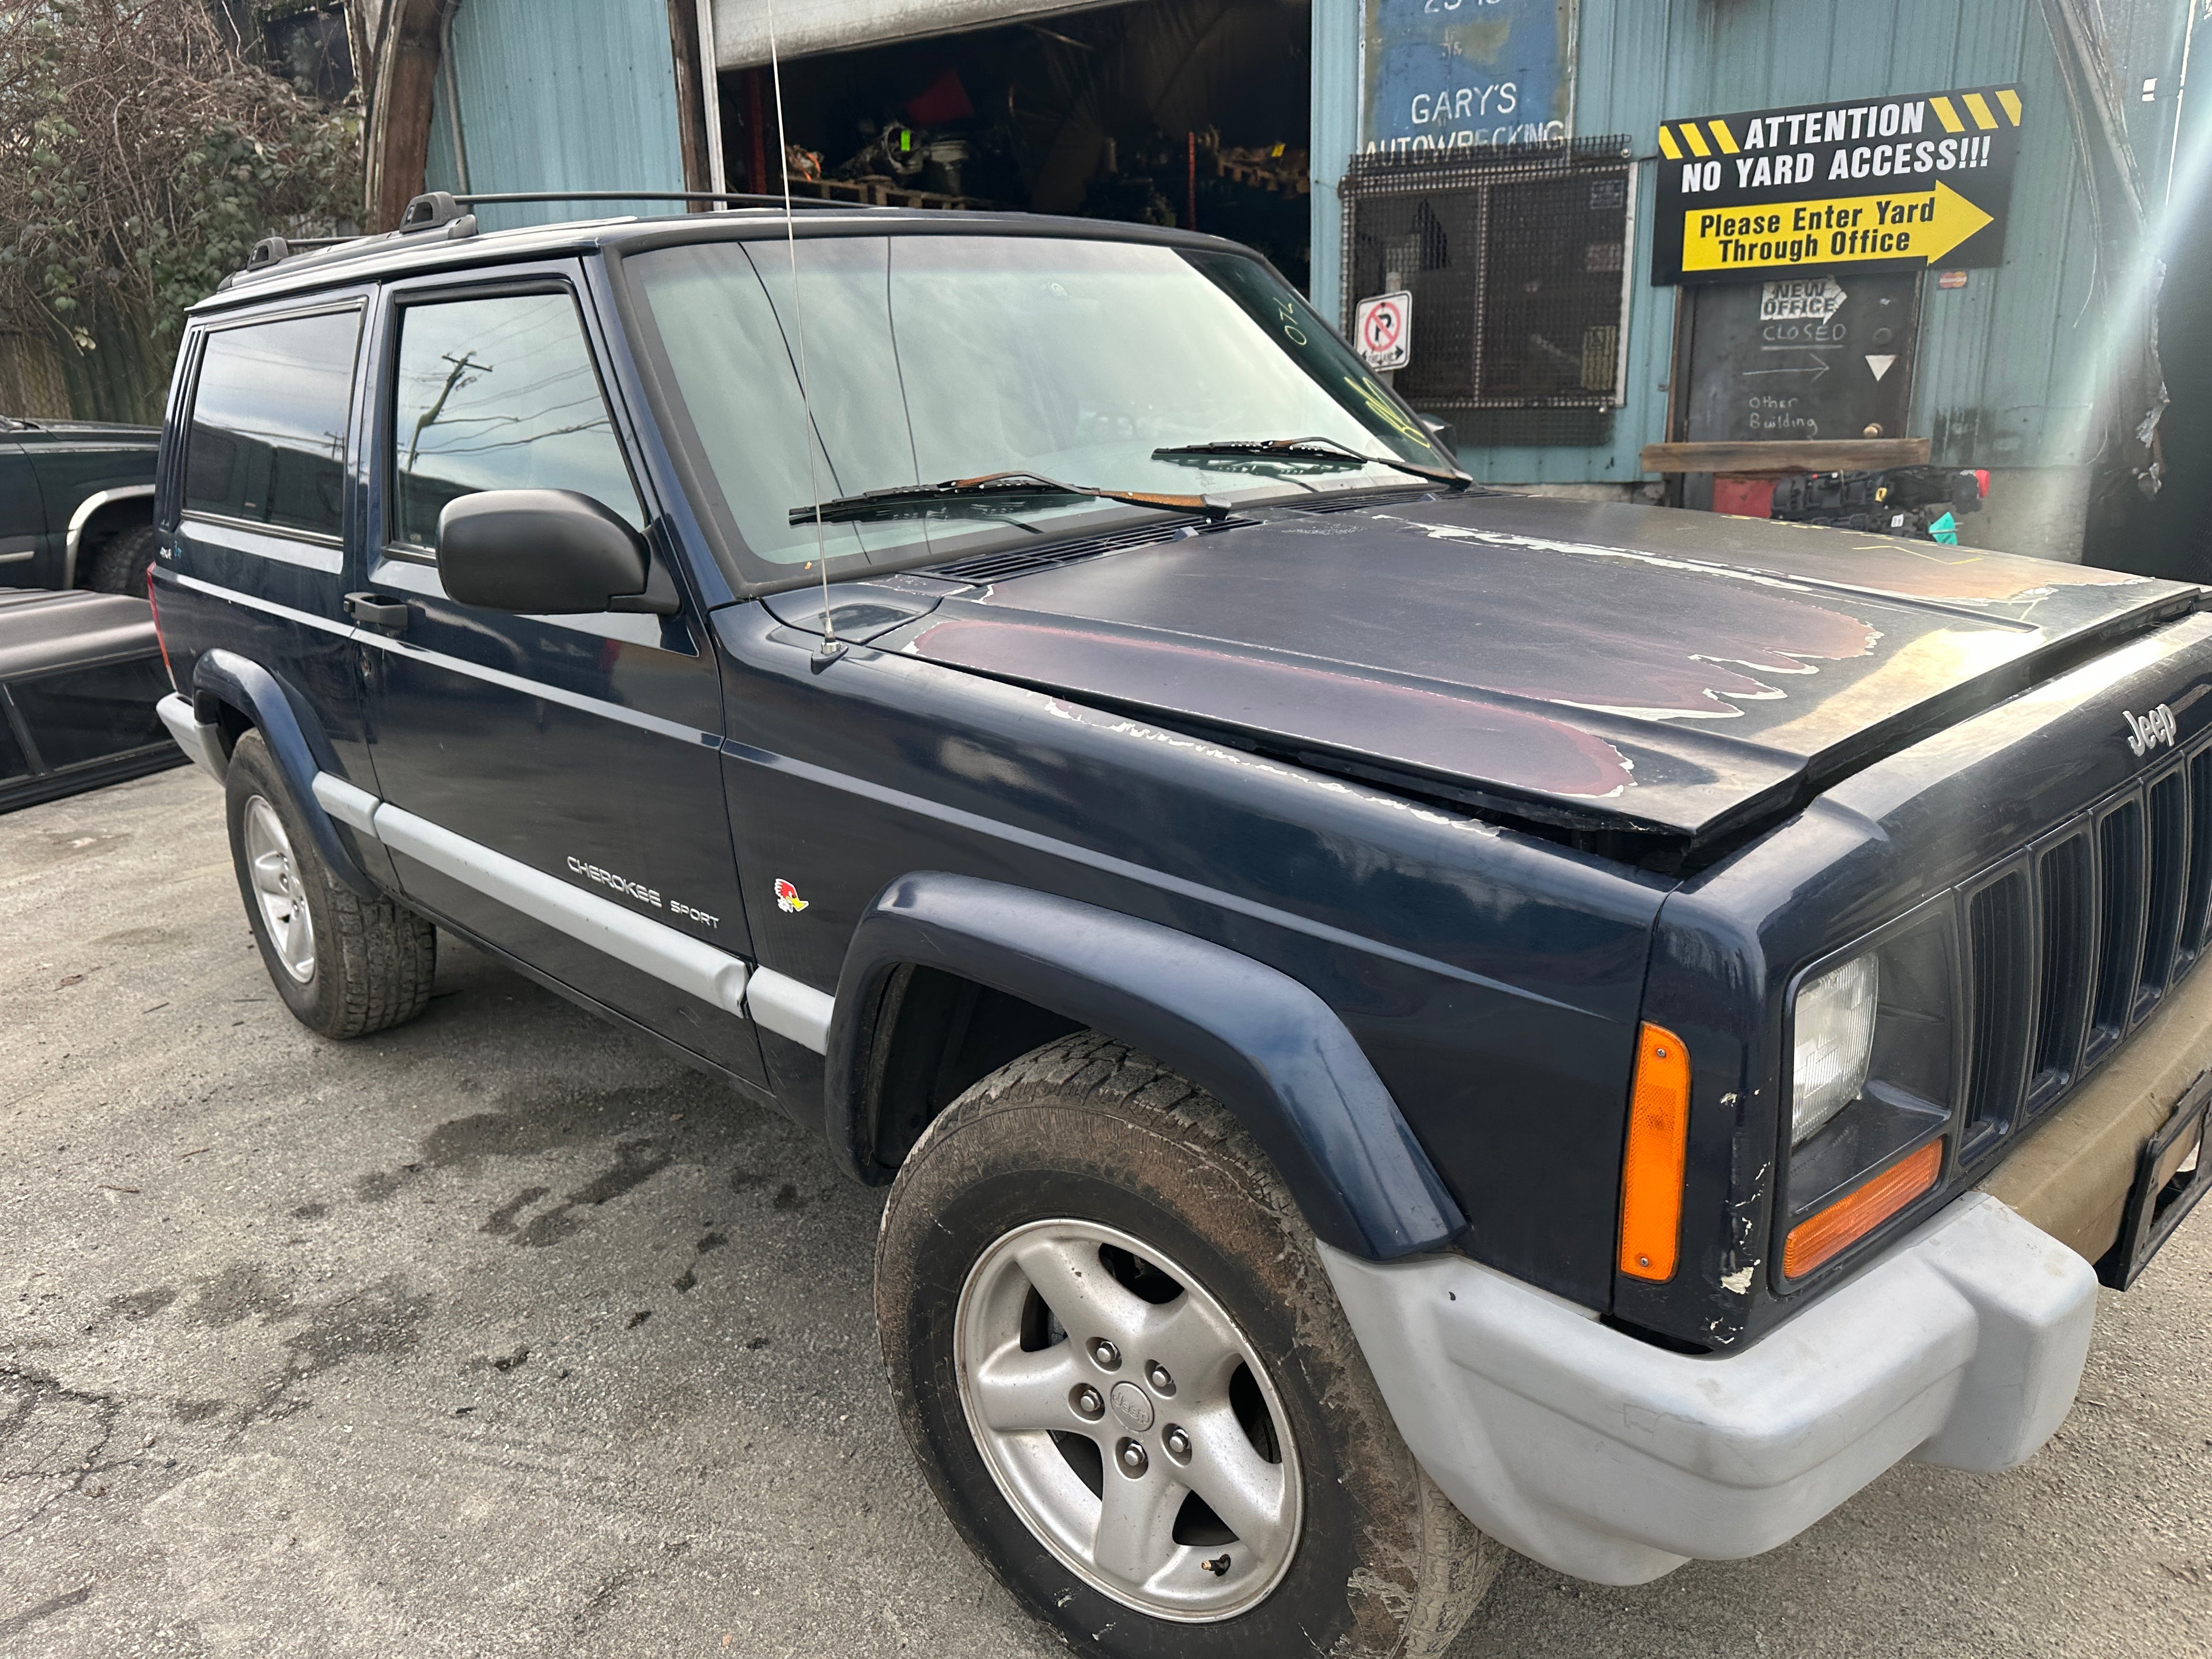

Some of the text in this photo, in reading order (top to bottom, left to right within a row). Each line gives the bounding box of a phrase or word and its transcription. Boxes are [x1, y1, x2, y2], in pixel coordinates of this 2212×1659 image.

[1411, 82, 1516, 124] GARY'S
[1744, 101, 1925, 150] ATTENTION
[1681, 136, 1990, 193] NO YARD ACCESS!!!
[1700, 197, 1935, 238] Please Enter Yard
[1719, 229, 1910, 262] Through Office
[1774, 281, 1826, 297] NEW
[1763, 297, 1838, 316] OFFICE
[1763, 323, 1846, 341] CLOSED
[1749, 395, 1798, 408] Other
[1750, 412, 1818, 440] Building
[2122, 703, 2176, 757] Jeep
[567, 856, 720, 929] CHEROKEE SPORT
[1112, 1392, 1150, 1425] Jeep
